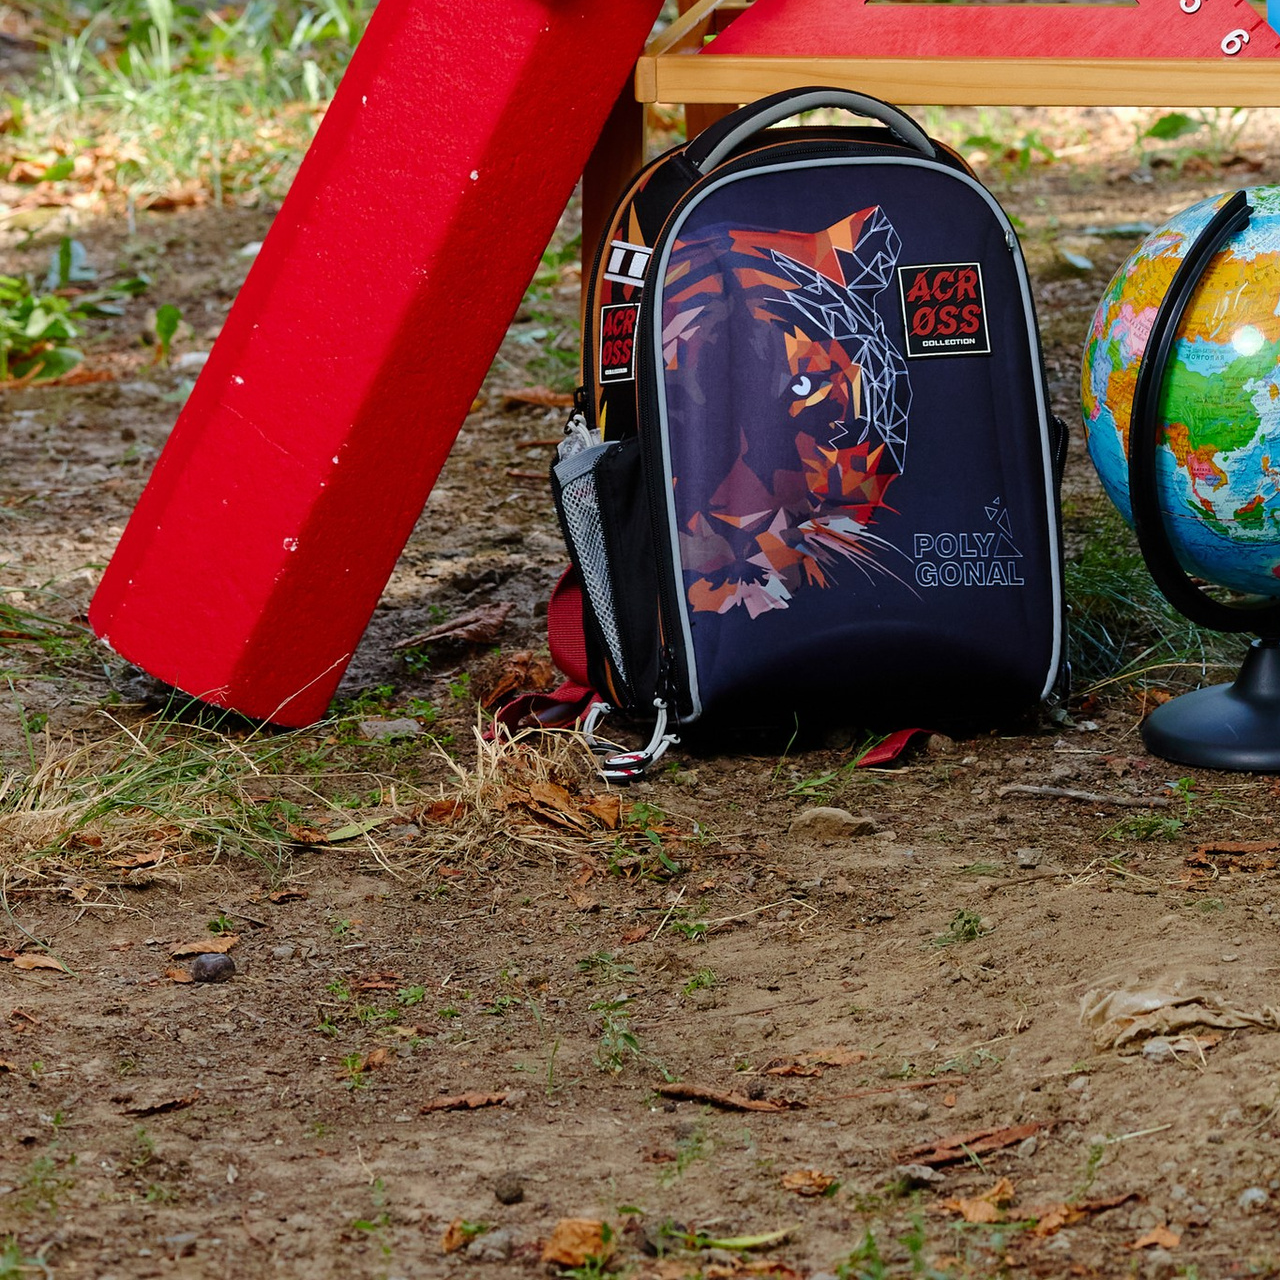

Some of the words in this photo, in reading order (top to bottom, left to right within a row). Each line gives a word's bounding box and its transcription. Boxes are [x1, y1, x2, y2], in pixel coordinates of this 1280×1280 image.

[1221, 28, 1249, 55] 6
[907, 267, 978, 305] ACR
[603, 308, 636, 338] ACR
[922, 338, 976, 347] COLLECTION
[914, 532, 995, 558] POLY
[915, 561, 1025, 587] GONAL
